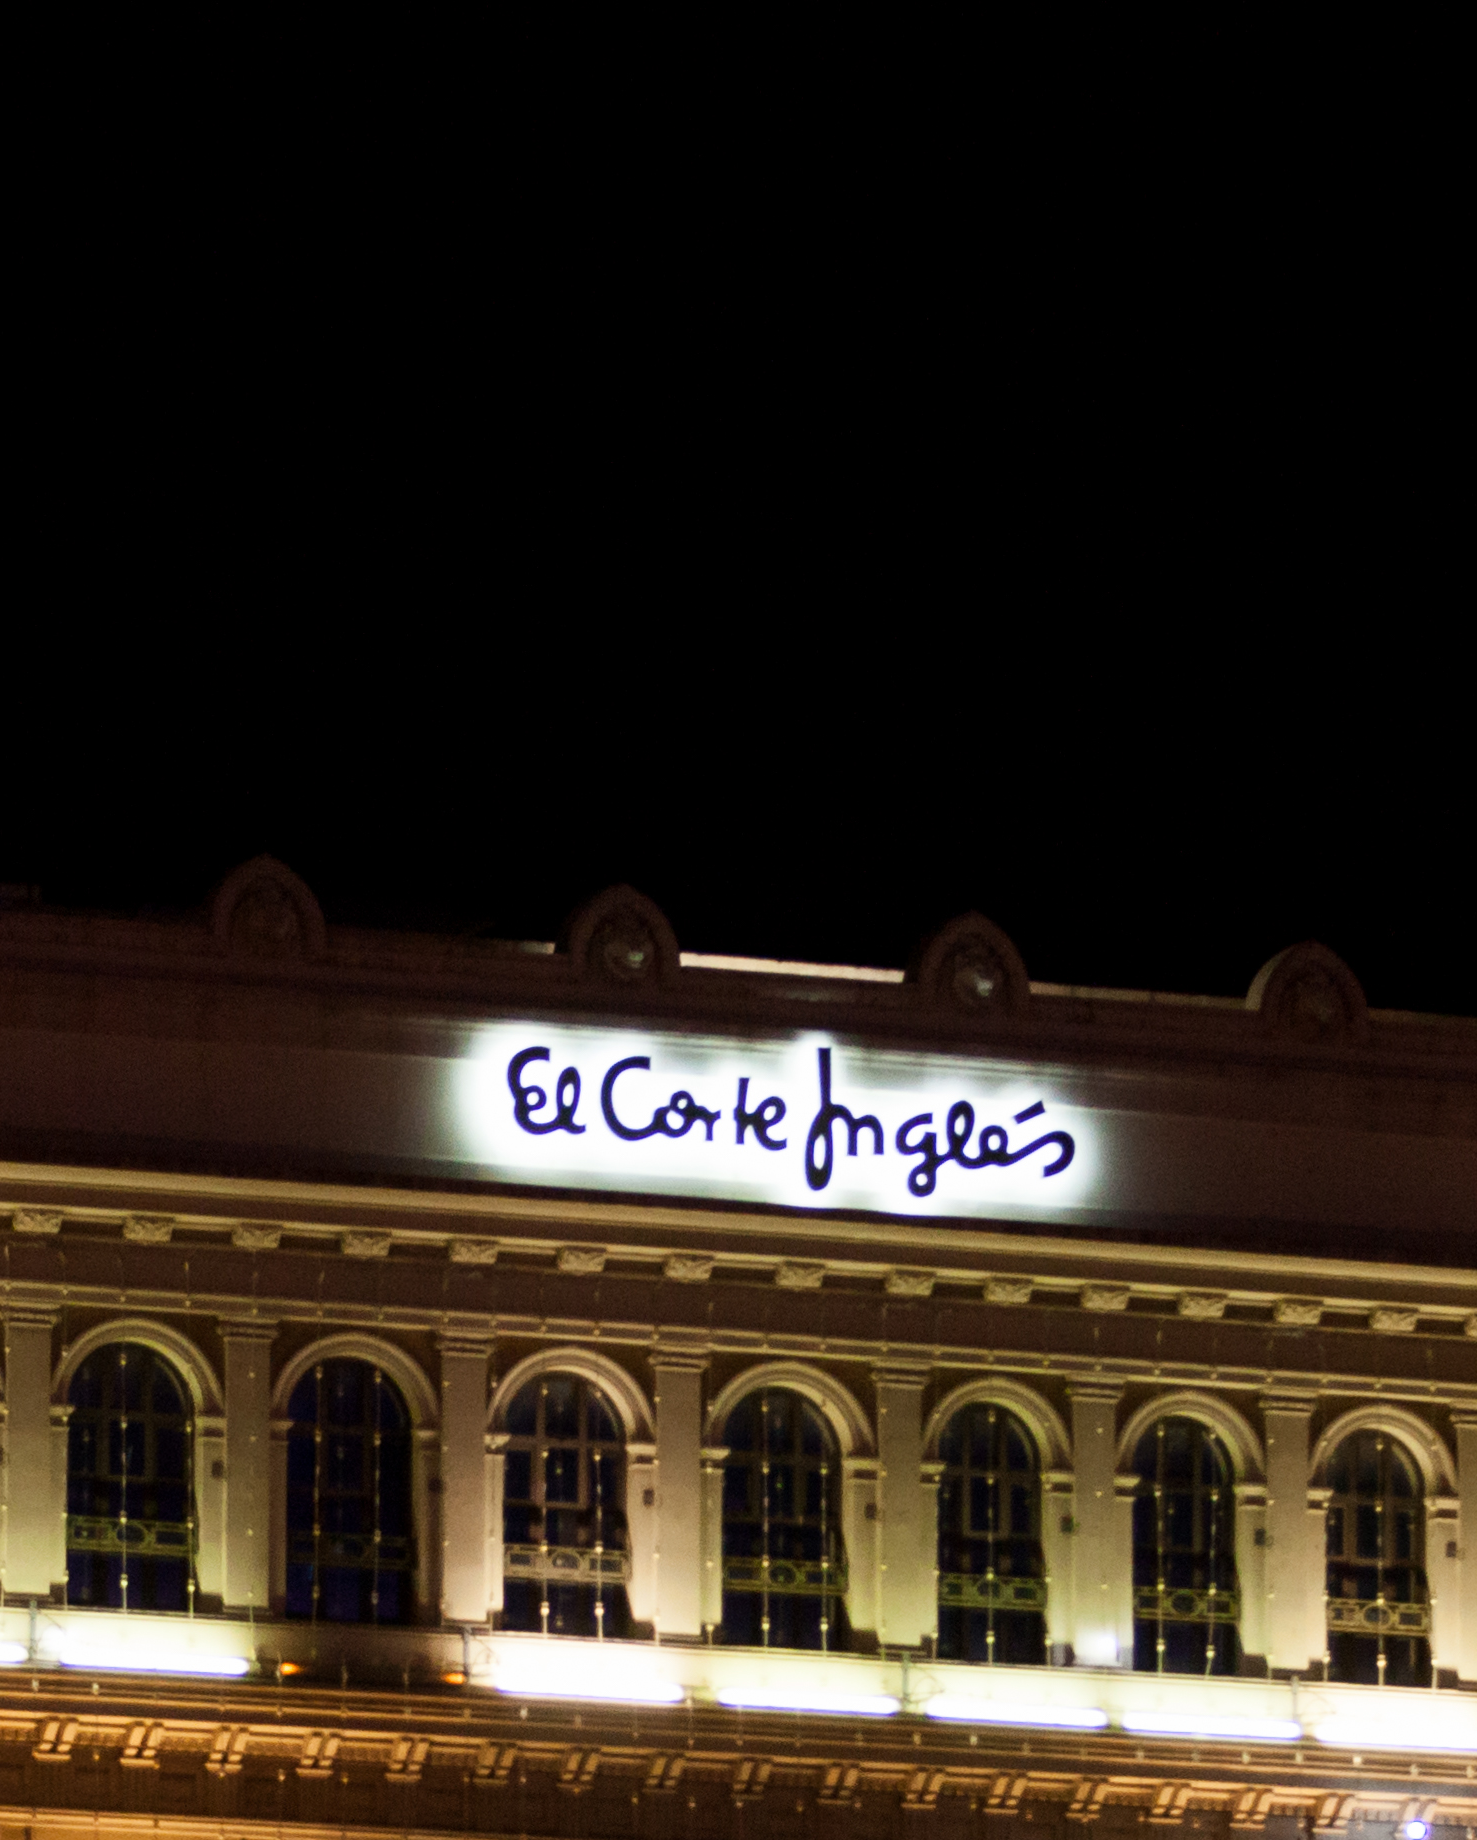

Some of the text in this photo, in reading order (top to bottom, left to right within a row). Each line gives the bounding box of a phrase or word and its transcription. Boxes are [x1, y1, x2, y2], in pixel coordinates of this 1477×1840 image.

[507, 1046, 1076, 1198] El Corte Inglés
